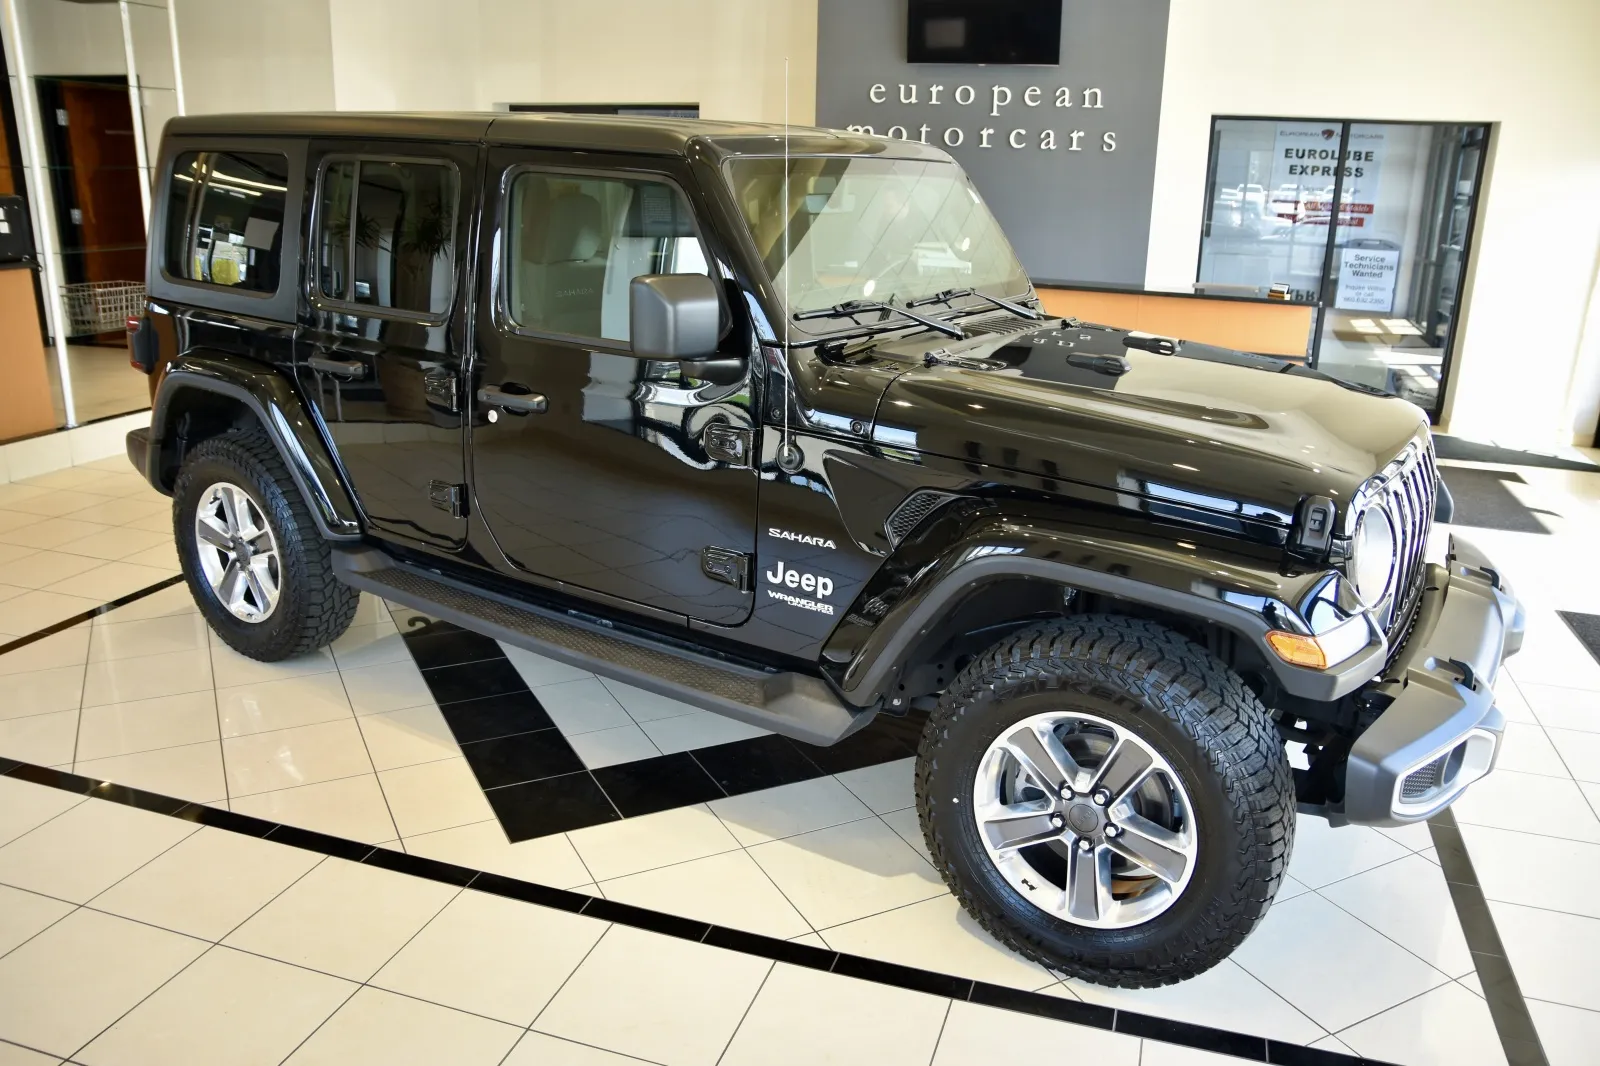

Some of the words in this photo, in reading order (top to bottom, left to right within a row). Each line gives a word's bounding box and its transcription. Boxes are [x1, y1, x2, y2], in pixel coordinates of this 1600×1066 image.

[869, 82, 1104, 116] european
[1344, 261, 1394, 271] Technicians
[1354, 254, 1386, 263] Service
[1352, 270, 1383, 278] Wanted
[768, 527, 836, 550] SAHARA
[766, 561, 834, 599] Jeep
[767, 589, 834, 611] WRANGLER
